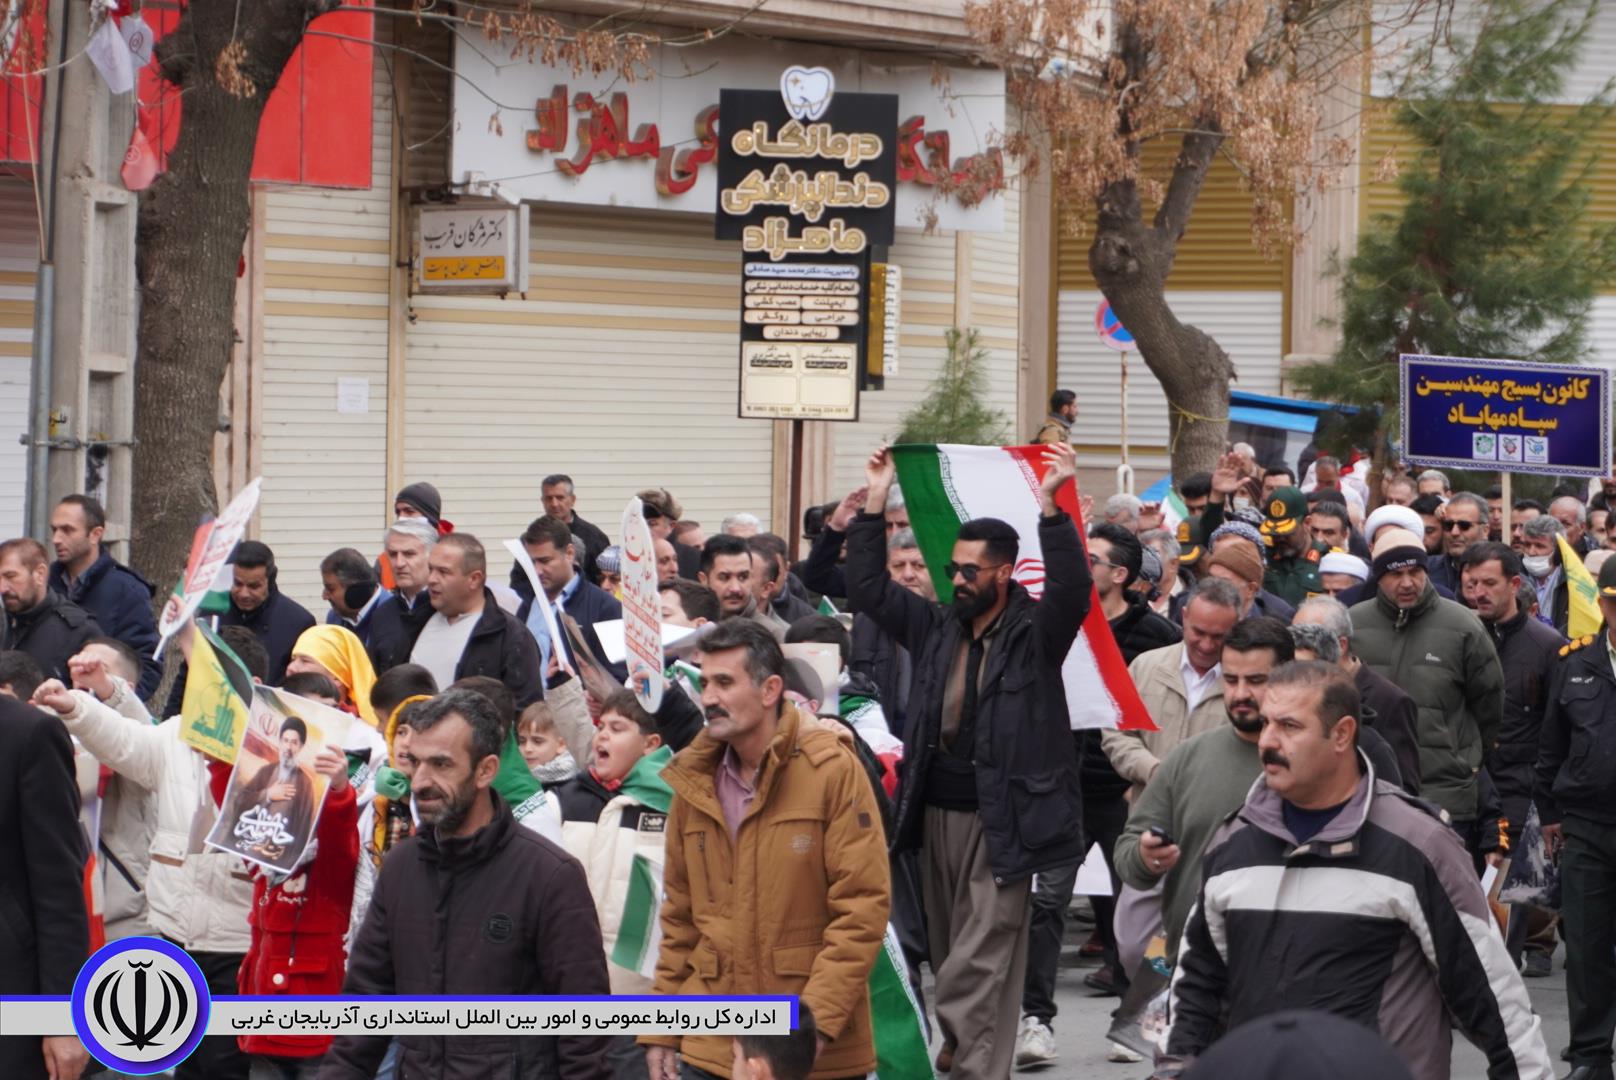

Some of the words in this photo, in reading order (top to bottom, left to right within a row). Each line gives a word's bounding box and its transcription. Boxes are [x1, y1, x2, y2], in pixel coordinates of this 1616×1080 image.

[731, 119, 883, 169] درمانگاه
[721, 162, 890, 223] دندانپزشکی
[424, 221, 455, 249] قریب
[453, 215, 486, 248] مژگان
[479, 215, 506, 248] دکتر
[743, 216, 866, 261] ماهزاد
[1416, 374, 1499, 397] مهندسین
[1501, 379, 1541, 402] بسیج
[1542, 377, 1591, 405] کانون
[1447, 402, 1507, 431] مهاباد
[1509, 406, 1558, 436] سپاه
